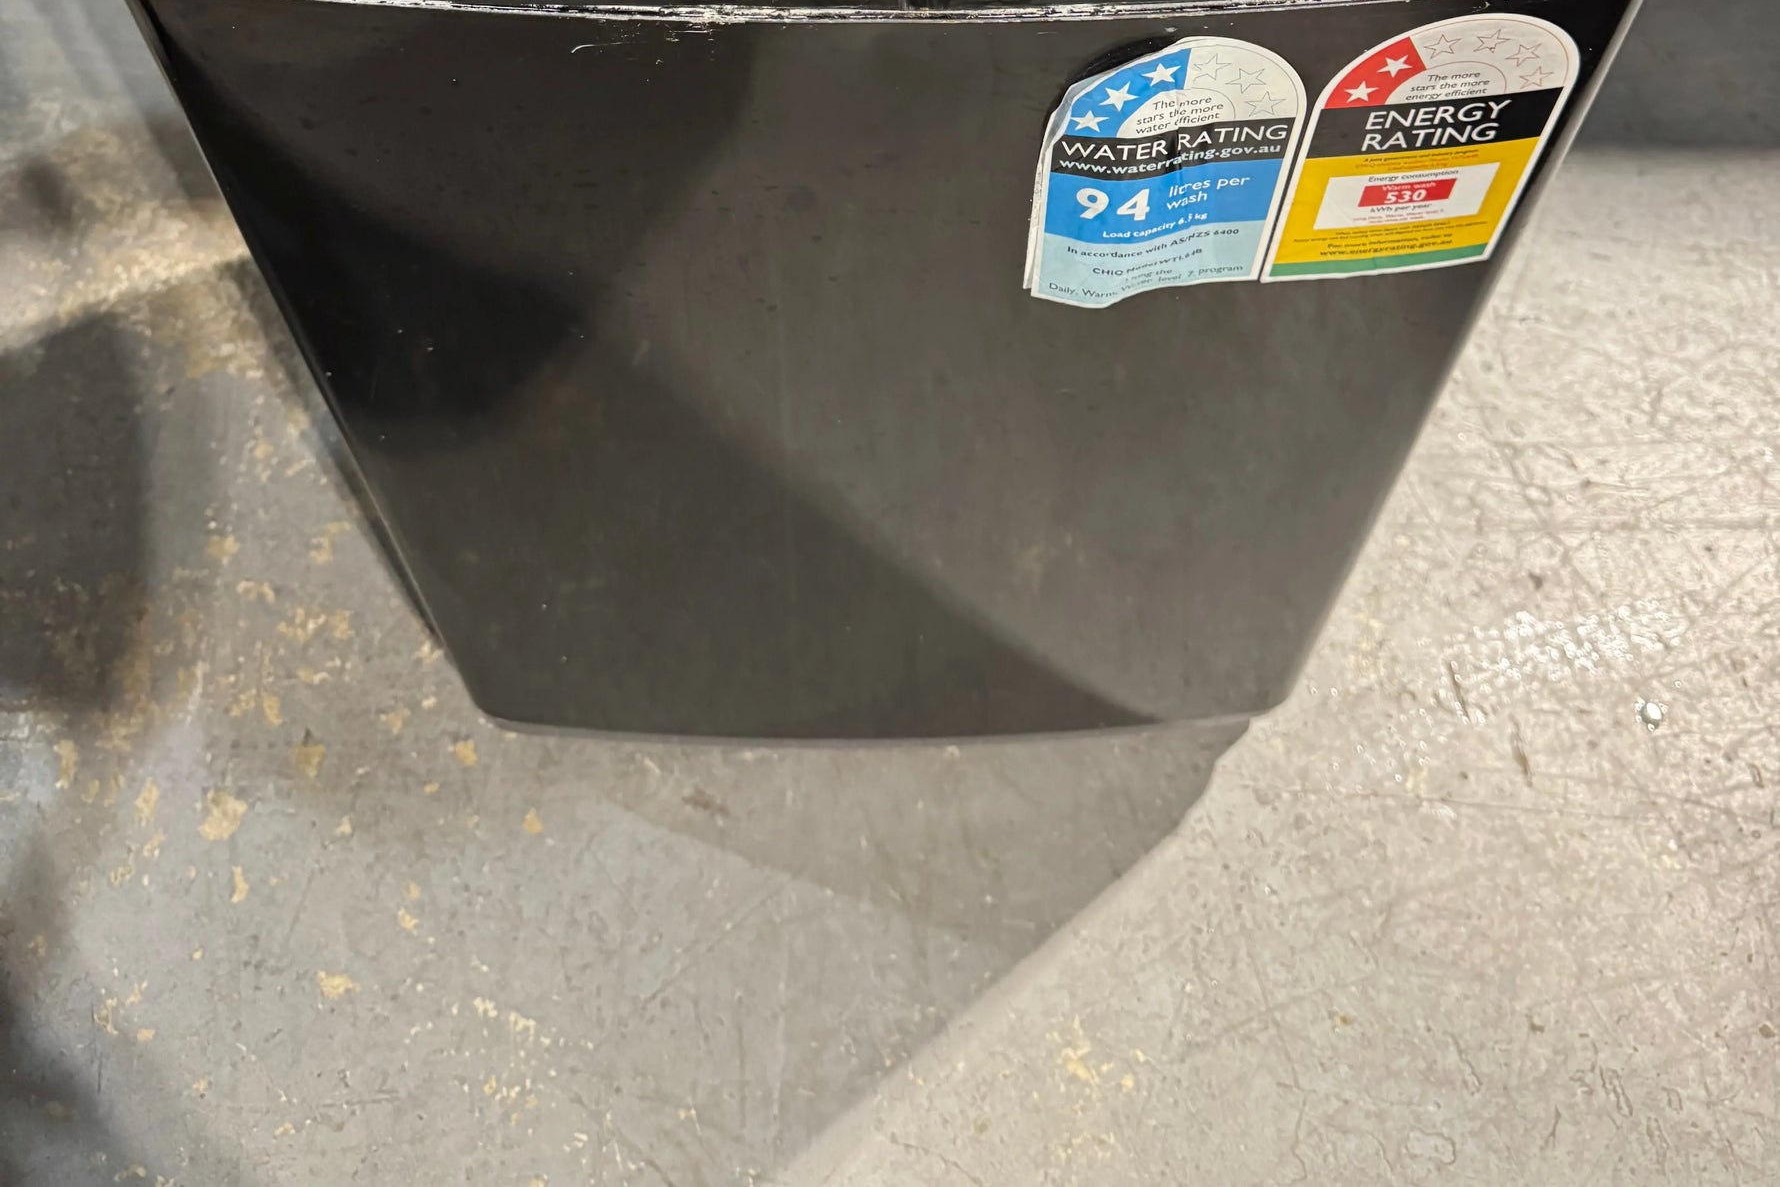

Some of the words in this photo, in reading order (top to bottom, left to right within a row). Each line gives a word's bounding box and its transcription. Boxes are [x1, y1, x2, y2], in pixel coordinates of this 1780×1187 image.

[1427, 73, 1447, 82] The
[1450, 71, 1481, 80] more
[1410, 83, 1434, 92] stars
[1437, 82, 1457, 90] the
[1460, 79, 1490, 88] more
[1405, 93, 1441, 101] energy
[1445, 88, 1487, 97] efficient
[1153, 100, 1175, 110] The
[1180, 97, 1212, 107] more
[1137, 114, 1167, 126] stars
[1191, 104, 1224, 114] more
[1365, 99, 1511, 131] ENERGY
[1136, 122, 1171, 134] water
[1062, 140, 1167, 161] WATER
[1177, 125, 1288, 148] RATING
[1360, 124, 1499, 152] RATING
[1059, 144, 1280, 175] www.waterrating.gov.au
[1368, 174, 1399, 182] Energy
[1401, 169, 1459, 181] consumption
[1169, 178, 1211, 197] litres
[1217, 177, 1250, 192] per
[1382, 183, 1411, 191] Warm
[1166, 192, 1208, 210] wash
[1384, 190, 1427, 204] 530
[1370, 204, 1392, 212] kWh
[1412, 203, 1432, 211] year
[1133, 221, 1176, 238] capacity
[1194, 213, 1208, 221] kg
[1067, 246, 1078, 254] In
[1145, 243, 1167, 254] with
[1198, 266, 1243, 275] program
